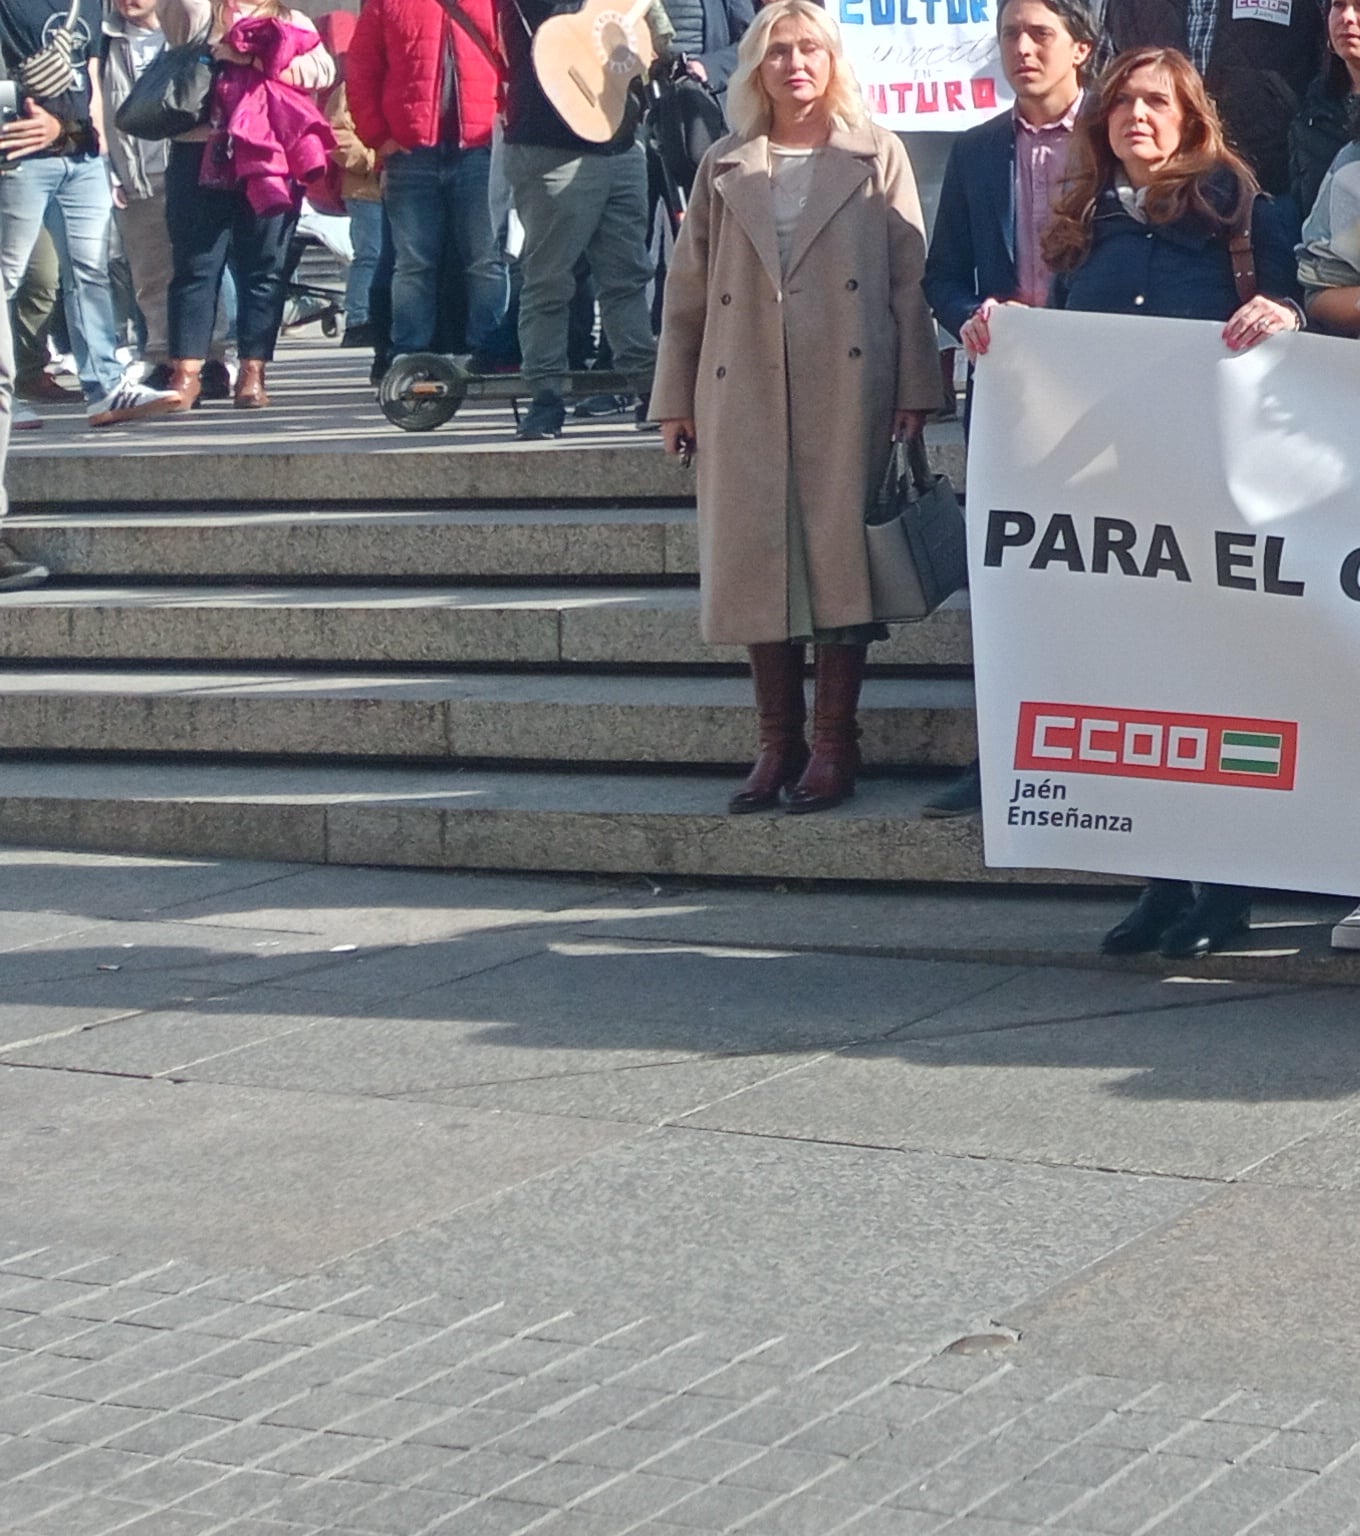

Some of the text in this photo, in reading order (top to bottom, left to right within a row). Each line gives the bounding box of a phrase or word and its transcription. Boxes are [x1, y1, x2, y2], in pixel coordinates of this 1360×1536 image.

[982, 509, 1192, 584] PARA
[1213, 529, 1306, 598] EL
[1031, 714, 1209, 771] CCOO
[1009, 778, 1068, 804] Jaén
[1006, 805, 1134, 834] Enseñanza
